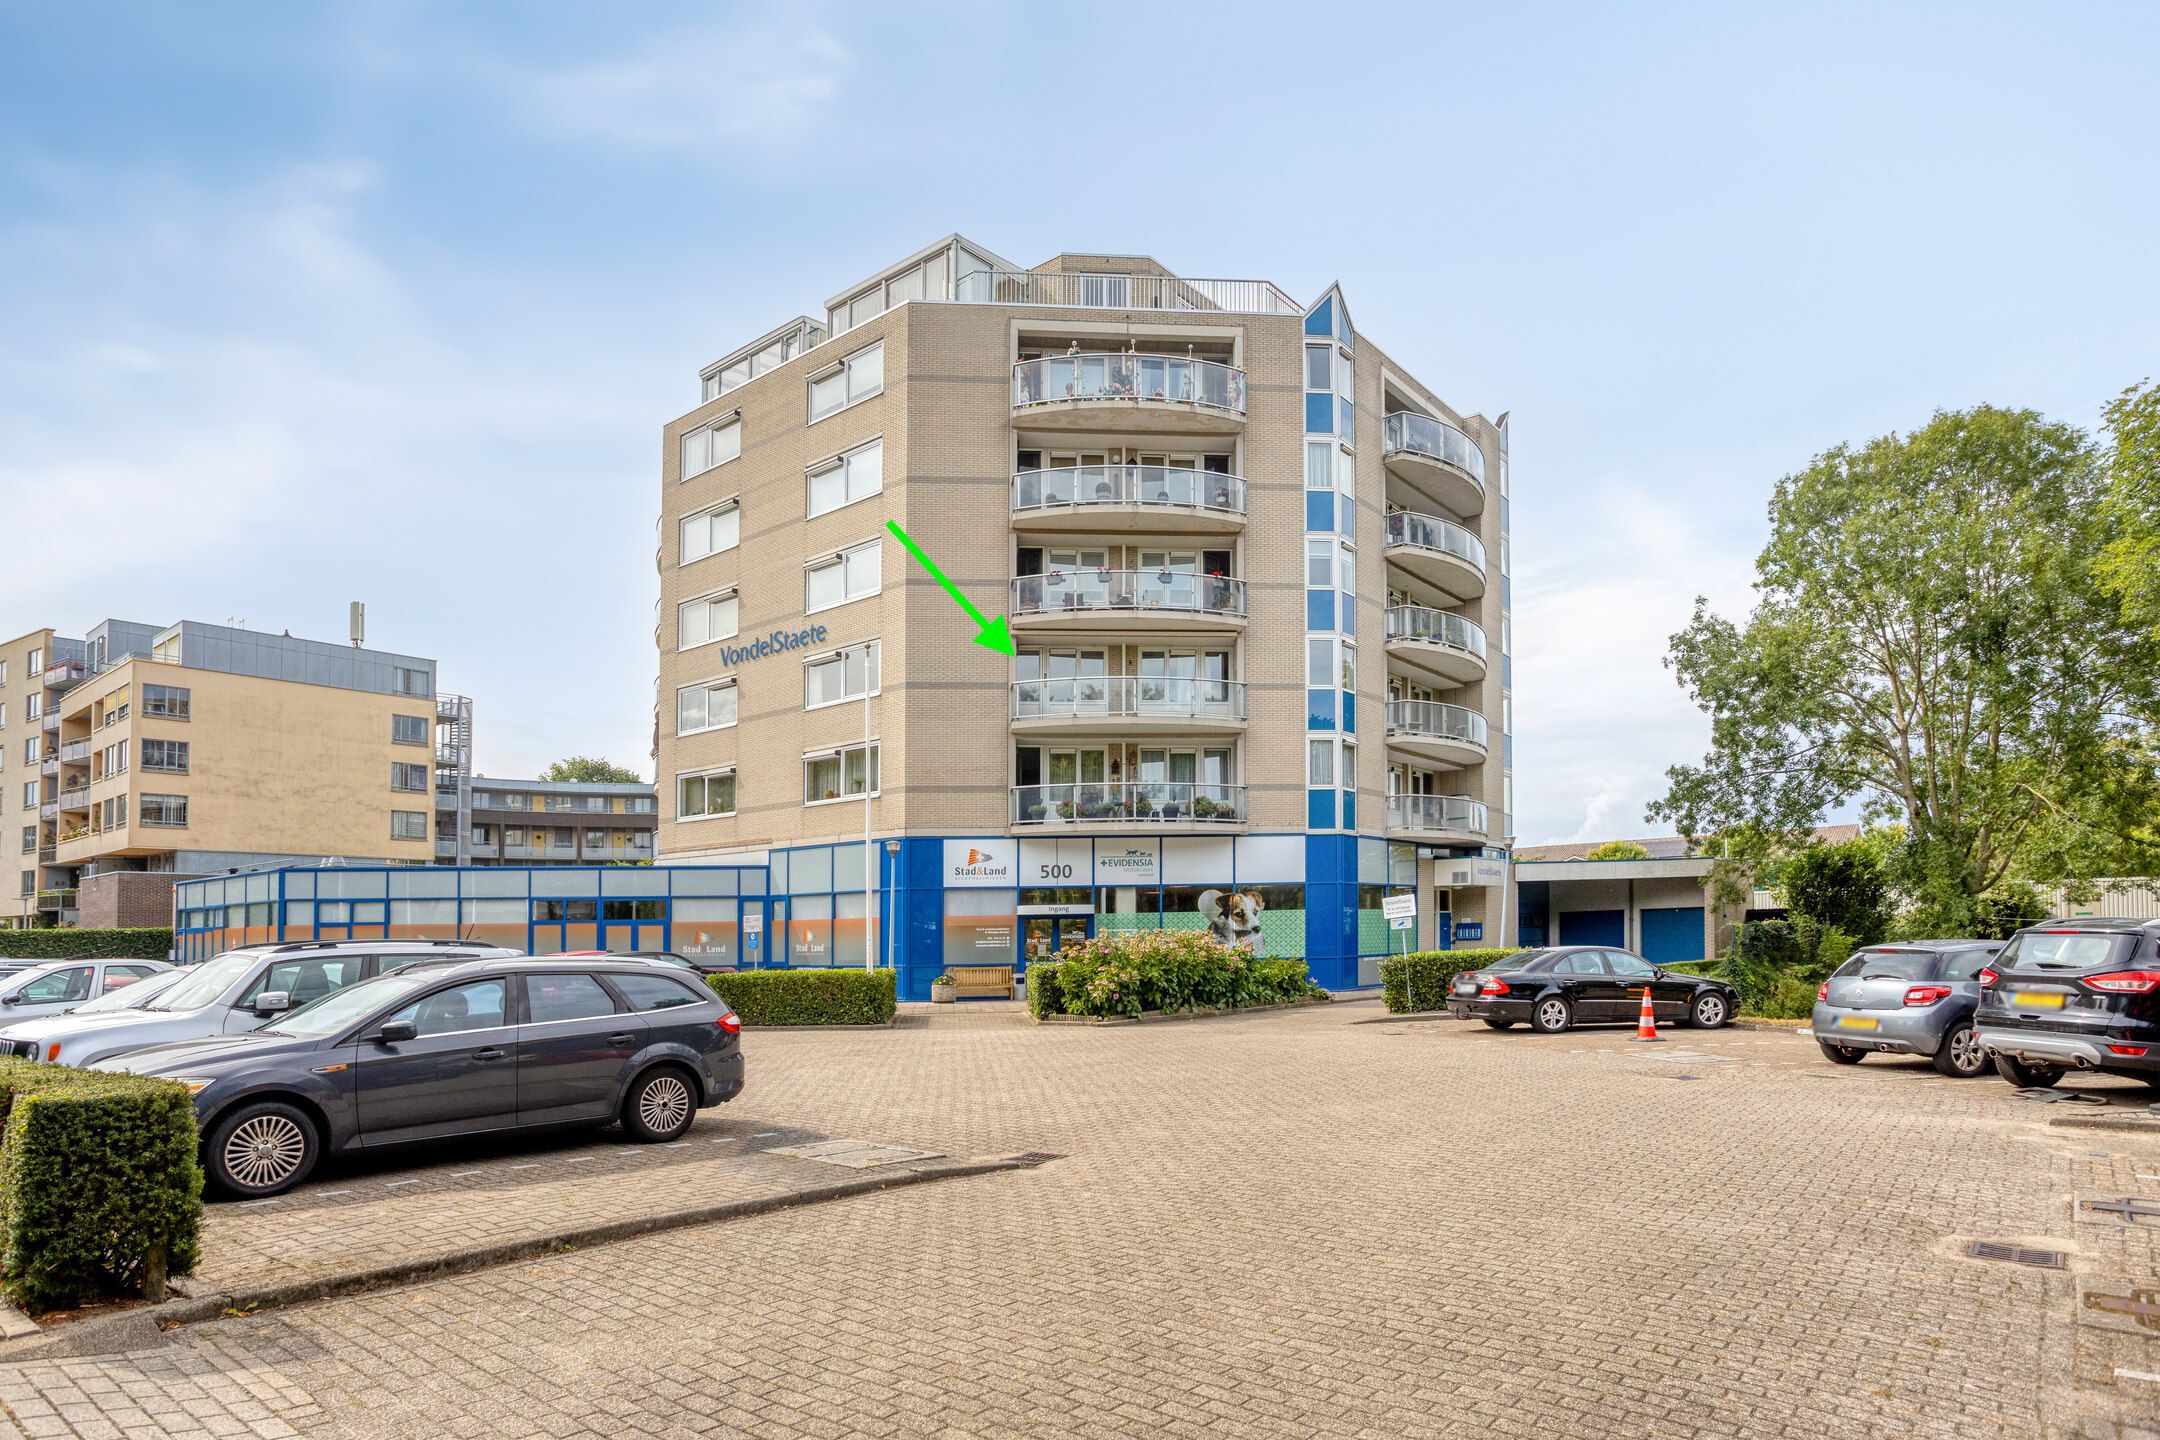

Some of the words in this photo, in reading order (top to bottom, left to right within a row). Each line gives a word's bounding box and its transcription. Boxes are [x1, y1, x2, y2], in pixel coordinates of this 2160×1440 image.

[720, 624, 826, 667] VondelStaete
[1108, 858, 1153, 867] EVIDENSIA
[955, 866, 1007, 876] Stad&Land
[1040, 864, 1073, 879] 500
